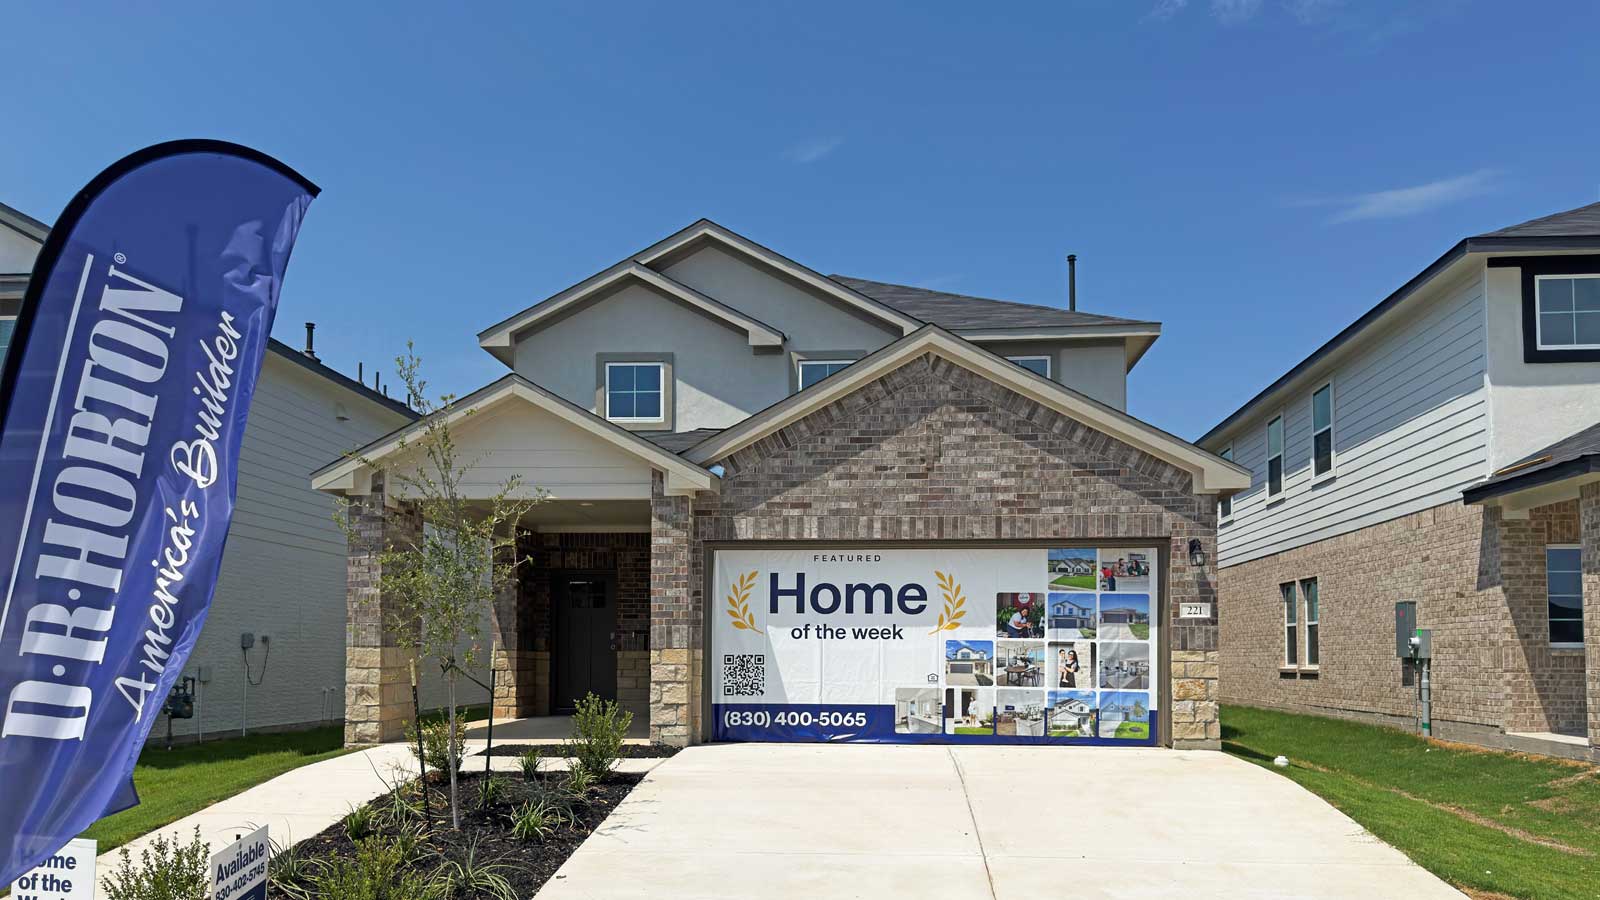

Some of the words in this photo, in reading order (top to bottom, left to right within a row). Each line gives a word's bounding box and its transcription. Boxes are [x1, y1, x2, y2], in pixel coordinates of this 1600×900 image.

[115, 499, 200, 725] America's
[171, 311, 243, 489] Builder
[813, 554, 882, 562] FEATURED
[769, 572, 928, 615] Home
[1186, 606, 1202, 615] 221
[790, 623, 811, 640] of
[815, 624, 847, 640] the
[852, 623, 904, 640] week
[723, 711, 771, 729] (830)
[774, 711, 867, 728] 400-5065
[38, 855, 77, 870] me
[216, 841, 265, 886] Available
[18, 873, 38, 890] of
[41, 874, 72, 893] the
